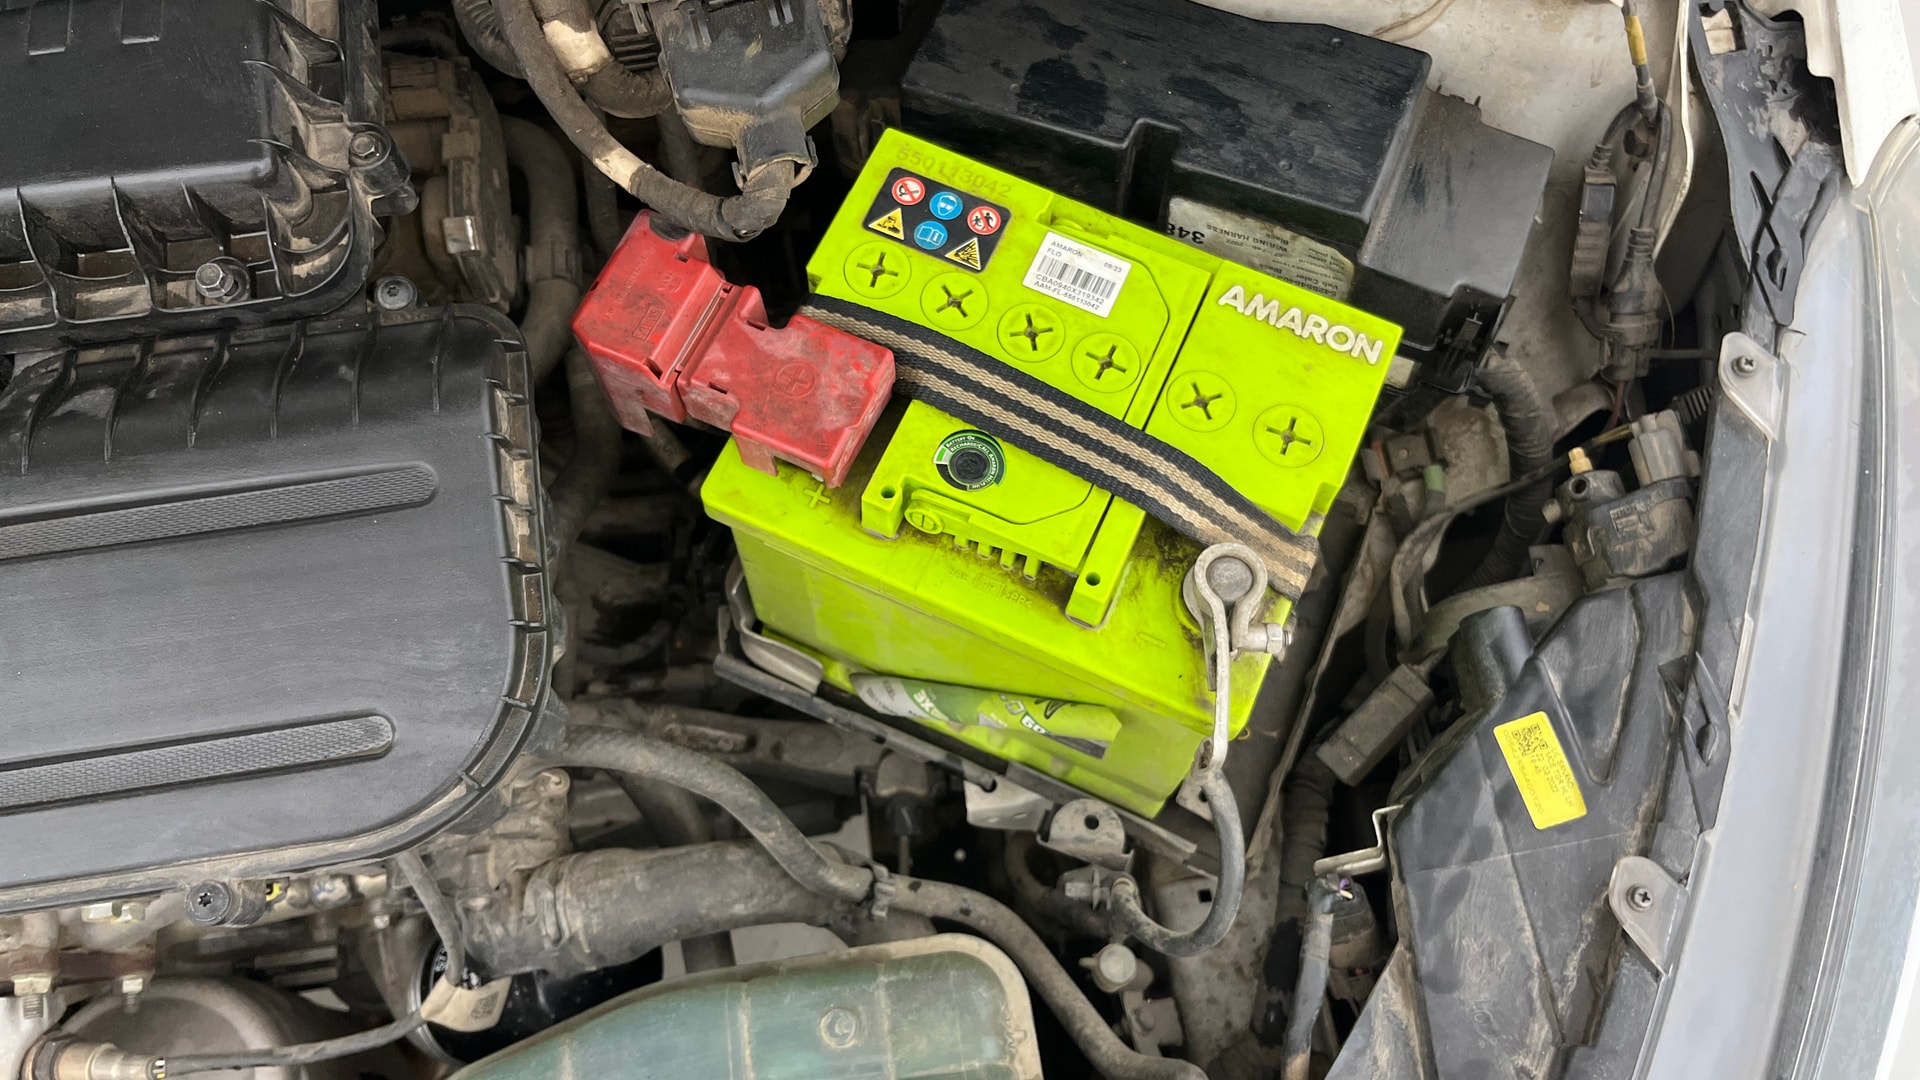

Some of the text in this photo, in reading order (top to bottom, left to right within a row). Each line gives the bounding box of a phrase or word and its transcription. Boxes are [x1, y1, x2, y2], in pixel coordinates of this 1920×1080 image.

[1045, 247, 1062, 258] FLO
[1049, 240, 1084, 258] AMARON
[1218, 285, 1383, 365] AMARON
